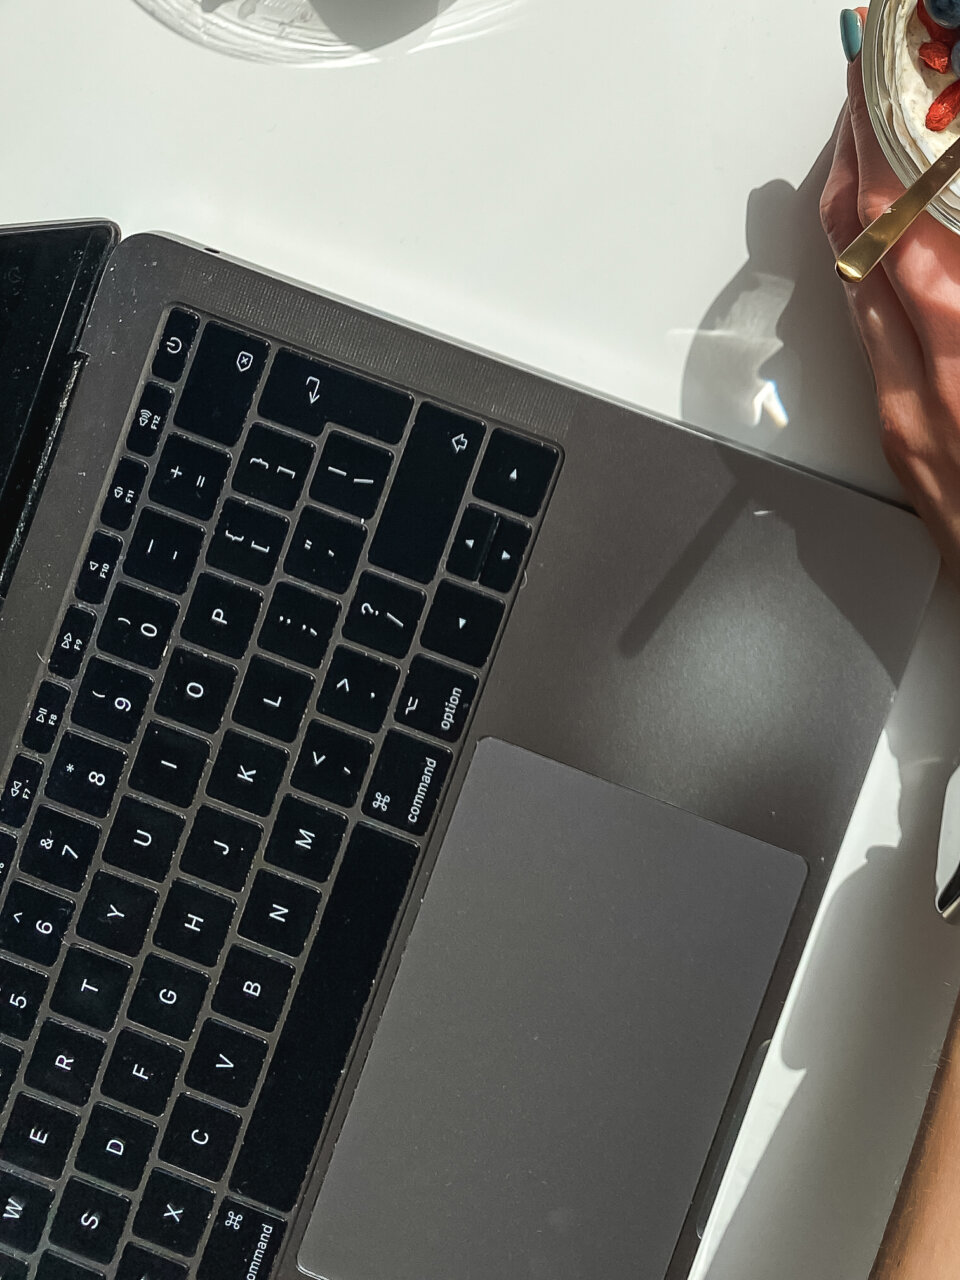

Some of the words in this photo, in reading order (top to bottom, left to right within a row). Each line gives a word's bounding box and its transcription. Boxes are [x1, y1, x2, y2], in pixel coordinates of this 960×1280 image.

[150, 414, 162, 430] F12
[125, 489, 135, 504] F11
[99, 563, 110, 579] F10
[211, 608, 228, 625] P
[73, 638, 83, 651] F9
[114, 697, 132, 712] 9
[263, 696, 282, 708] L
[441, 687, 462, 730] option
[48, 713, 58, 726] F8
[88, 771, 106, 786] 8
[236, 764, 257, 783] K
[22, 788, 31, 800] F7
[407, 756, 437, 823] command
[133, 829, 152, 847] U
[294, 828, 316, 850] M
[61, 844, 79, 859] 7
[213, 839, 230, 855] J
[106, 904, 125, 918] Y
[268, 903, 289, 923] N
[35, 919, 53, 935] 6
[184, 913, 204, 932] H
[80, 978, 99, 992] T
[242, 980, 261, 997] B
[9, 993, 27, 1009] 5
[158, 988, 177, 1005] G
[54, 1054, 75, 1071] R
[215, 1053, 235, 1068] V
[132, 1063, 149, 1080] F
[29, 1128, 49, 1144] E
[191, 1129, 209, 1145] C
[105, 1139, 124, 1156] D
[2, 1197, 23, 1219] W
[163, 1203, 184, 1223] X
[80, 1211, 99, 1230] S
[246, 1223, 273, 1280] ommand
